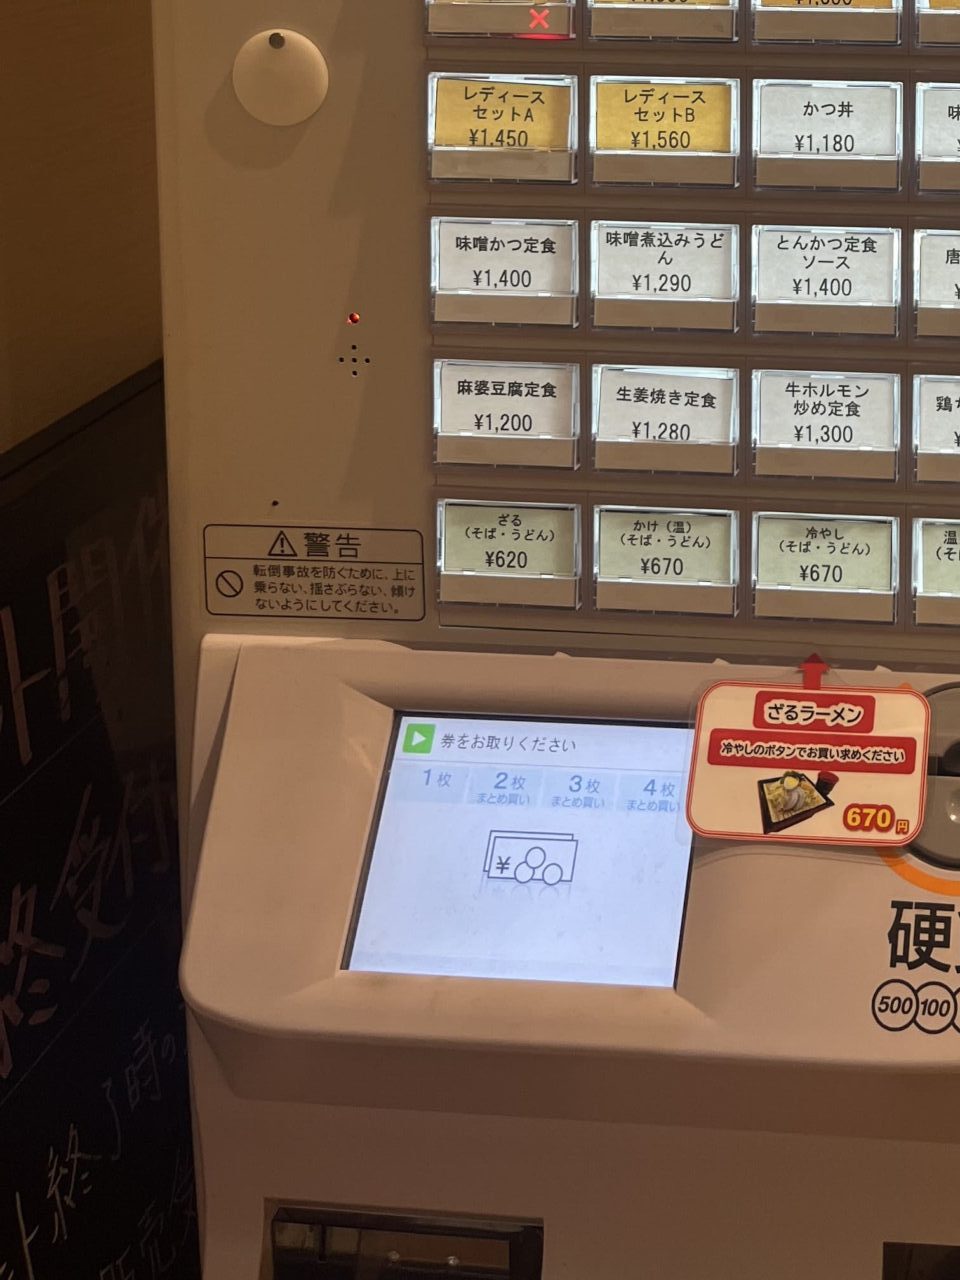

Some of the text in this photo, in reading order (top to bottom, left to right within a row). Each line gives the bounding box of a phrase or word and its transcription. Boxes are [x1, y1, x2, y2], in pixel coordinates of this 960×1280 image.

[463, 86, 547, 106] レディース
[625, 88, 705, 104] レディース
[804, 101, 853, 117] かつ丼
[456, 236, 556, 254] 味噌かつ定食
[458, 379, 557, 398] 麻婆豆腐定食
[617, 386, 716, 408] 生姜焼き定食
[498, 514, 521, 526] ざる
[806, 526, 844, 544] 冷やし
[303, 532, 362, 558] 警告
[486, 551, 527, 568] ¥620
[641, 557, 683, 575] ¥670
[253, 563, 416, 581] 転倒事故を防ぐために、上に
[800, 564, 842, 582] ¥670
[253, 581, 416, 598] 乗らない、揺さぶらない、傾け
[257, 598, 400, 614] ないようにしてください。
[767, 702, 863, 727] ざるラーメン
[440, 733, 577, 753] 券をお取りください
[721, 741, 906, 764] 冷やしのボタンでお買い求めください
[476, 792, 530, 807] まとめ買い
[551, 795, 605, 809] まとめ買い
[877, 995, 914, 1016] 500
[919, 997, 951, 1018] 100
